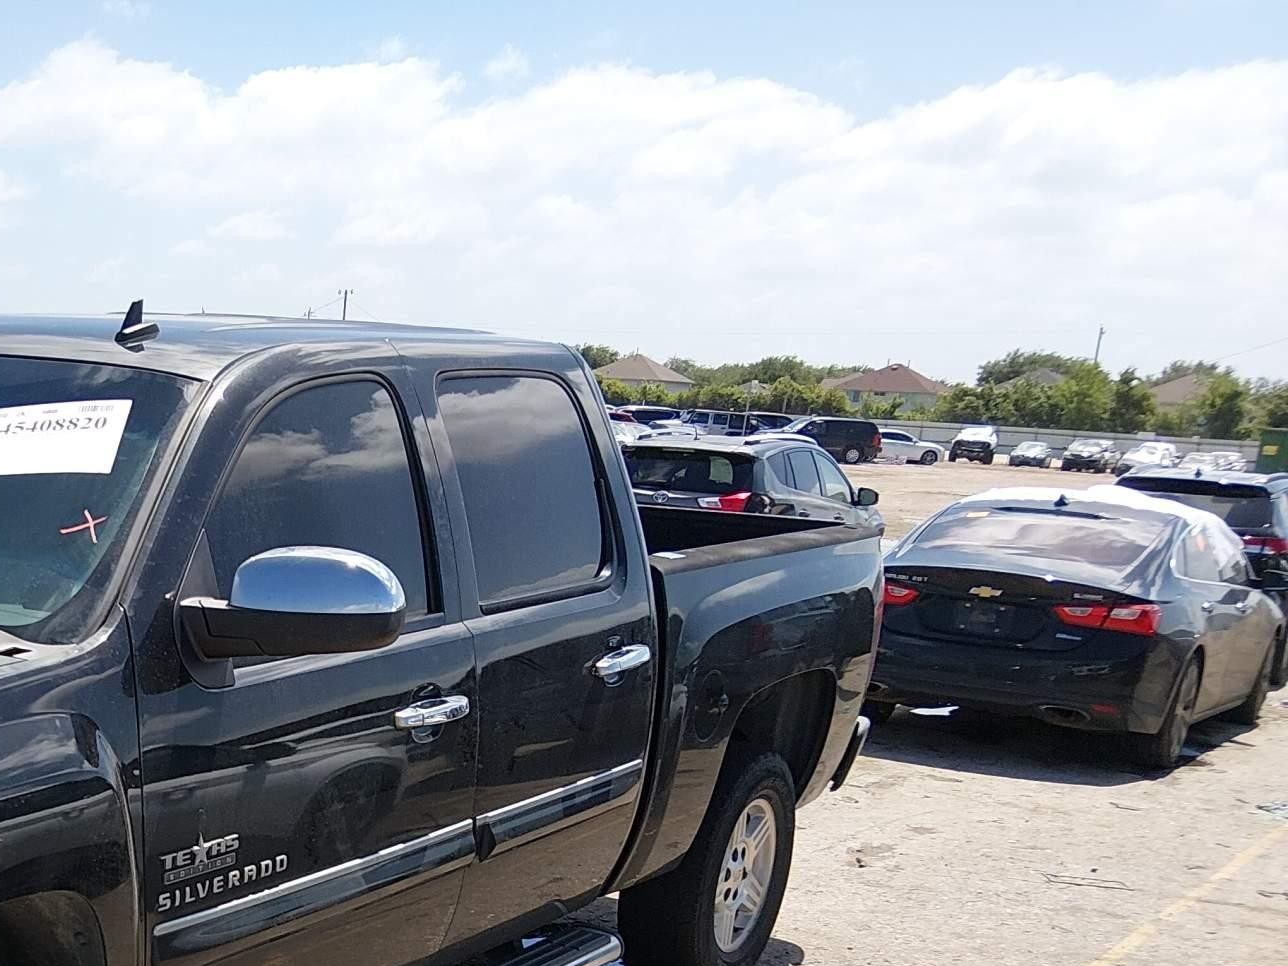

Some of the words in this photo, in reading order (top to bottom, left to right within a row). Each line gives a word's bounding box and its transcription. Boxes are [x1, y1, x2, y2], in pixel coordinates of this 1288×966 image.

[0, 416, 108, 435] 45408820
[161, 832, 240, 870] TEXAS
[157, 854, 289, 912] SILVERADO
